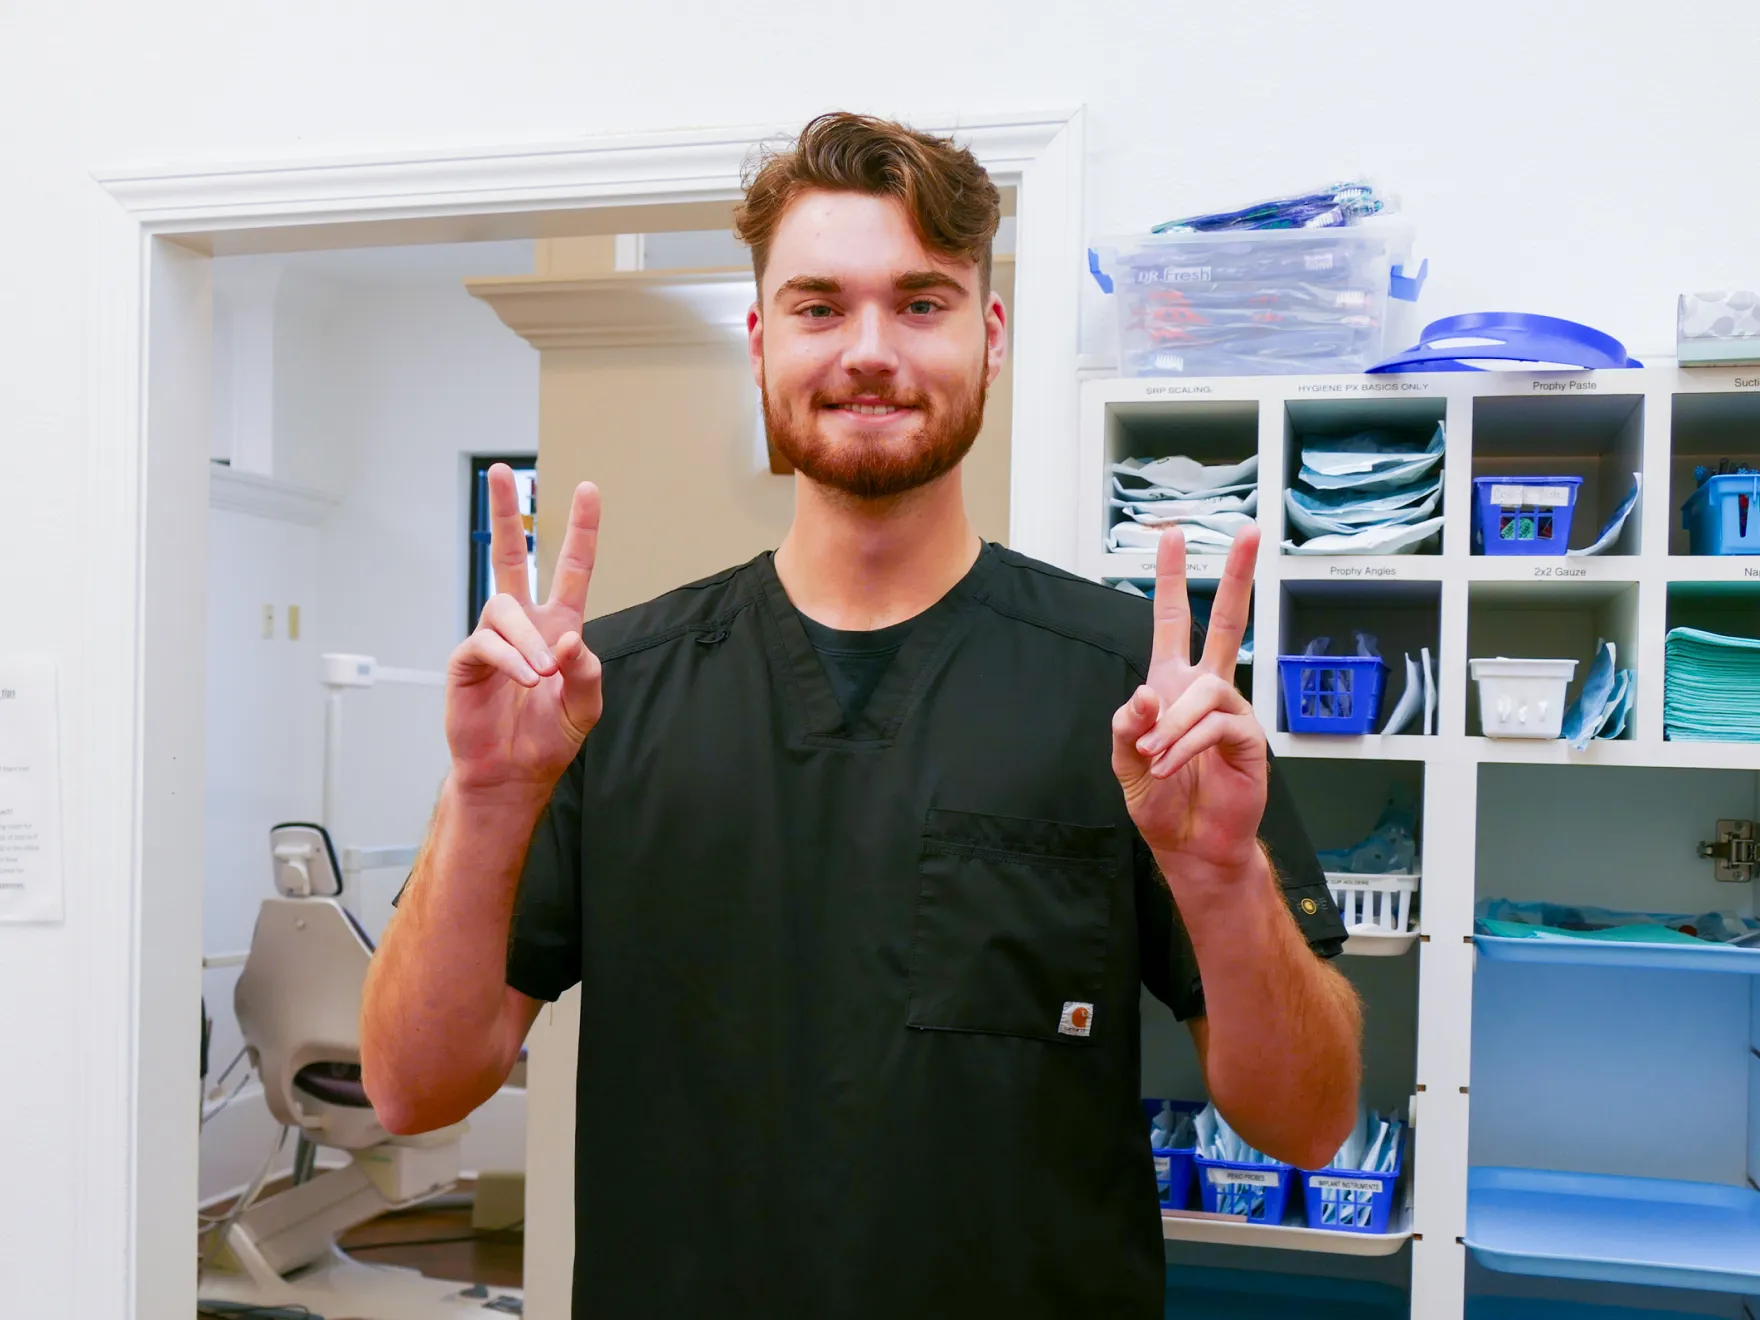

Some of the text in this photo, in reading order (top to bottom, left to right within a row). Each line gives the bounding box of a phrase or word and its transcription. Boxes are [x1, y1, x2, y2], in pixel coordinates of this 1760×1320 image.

[1164, 266, 1210, 282] Fresh
[1298, 384, 1342, 392] HYGIENE
[1361, 383, 1399, 391] BASICS
[1401, 383, 1429, 391] ONLY
[1532, 380, 1597, 391] Prophy Paste
[1146, 387, 1166, 395] SRP
[1330, 566, 1397, 576] Prophy Angles
[1534, 567, 1587, 577] 2x2 Gauze
